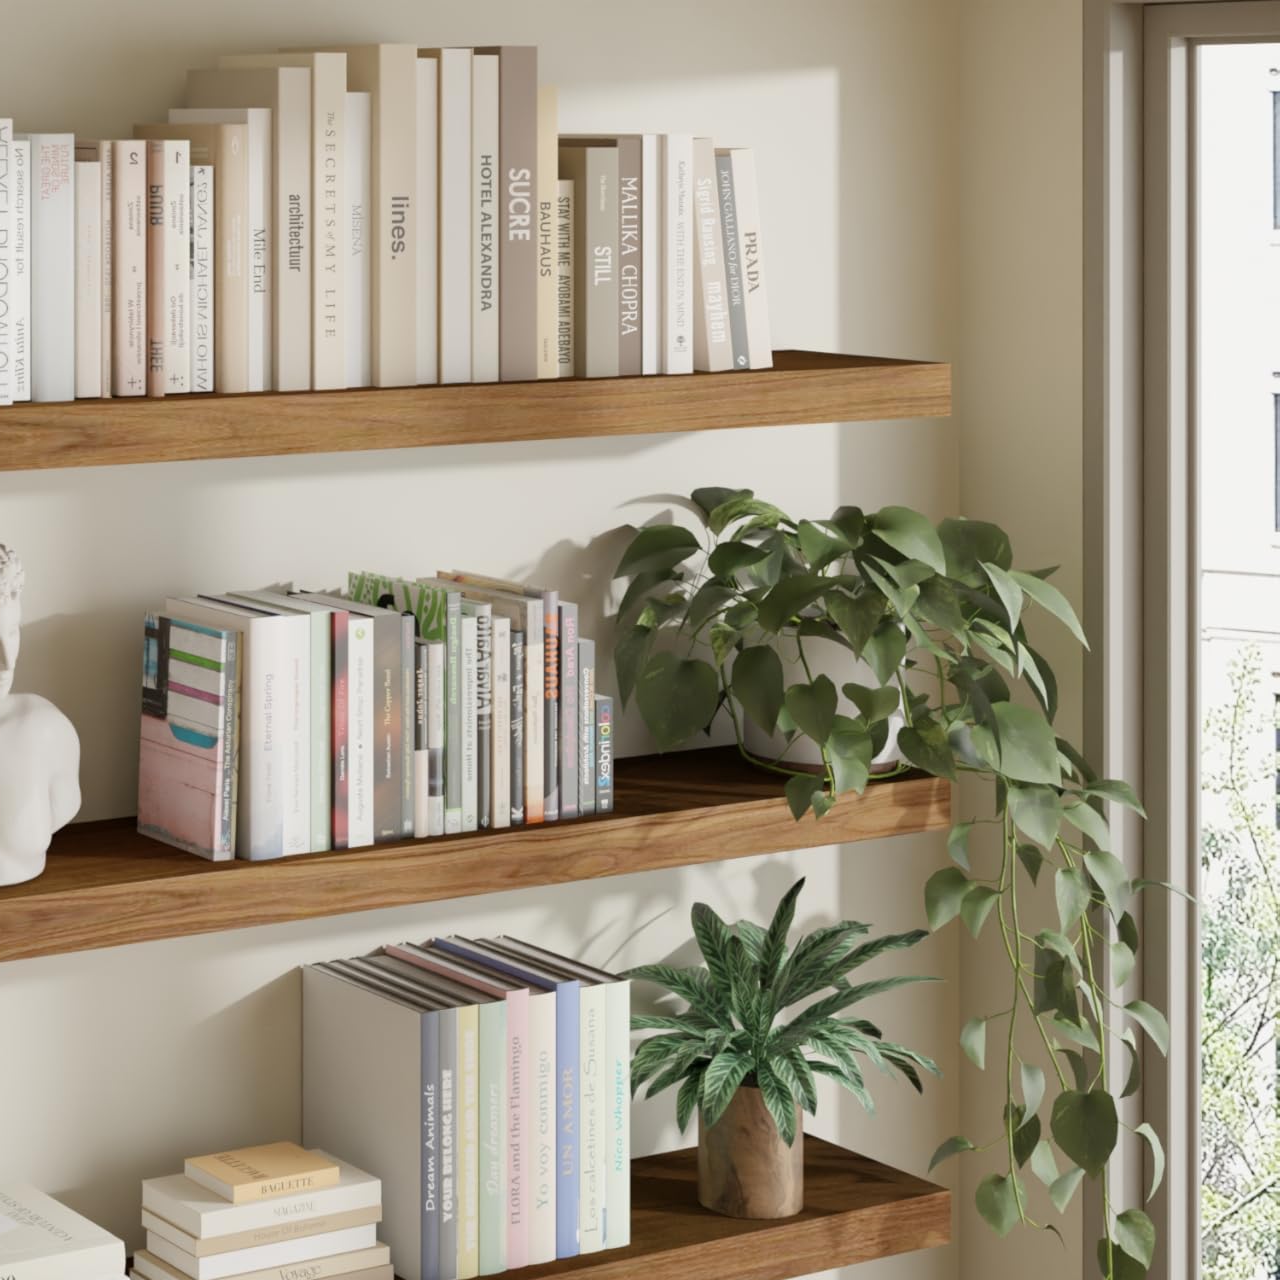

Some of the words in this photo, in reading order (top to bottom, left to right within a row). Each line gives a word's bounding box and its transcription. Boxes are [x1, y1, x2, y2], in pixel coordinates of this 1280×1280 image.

[481, 155, 492, 200] HOTEL
[721, 169, 732, 200] JOHN
[509, 168, 531, 241] SUCRE
[558, 196, 570, 223] STAY
[621, 177, 638, 255] MALLIKA
[253, 229, 266, 260] Mile
[289, 194, 304, 272] architectuur
[391, 196, 410, 260] lines.
[540, 202, 551, 277] BAUHAUS
[558, 225, 570, 248] WITH
[723, 202, 737, 260] GALLIANO
[253, 264, 266, 293] End
[481, 204, 492, 312] ALEXANDRA
[558, 252, 570, 266] ME
[594, 246, 612, 285] STILL
[728, 262, 738, 275] for
[744, 231, 760, 293] PRADA
[558, 275, 570, 318] AYOBAMI
[621, 265, 638, 335] CHOPRA
[730, 277, 741, 306] DIOR
[558, 321, 571, 364] ADEBAYO
[511, 1036, 522, 1109] Flamingo
[537, 1051, 551, 1135] conmigo
[614, 1058, 625, 1131] Whopper
[424, 1083, 435, 1151] Animals
[511, 1113, 521, 1138] the
[511, 1143, 521, 1171] and
[539, 1144, 551, 1177] voy
[615, 1138, 624, 1171] Nico
[261, 1177, 313, 1194] BAGUETTE
[425, 1156, 435, 1211] Dream
[511, 1175, 521, 1225] FLORA
[536, 1184, 549, 1209] Yo
